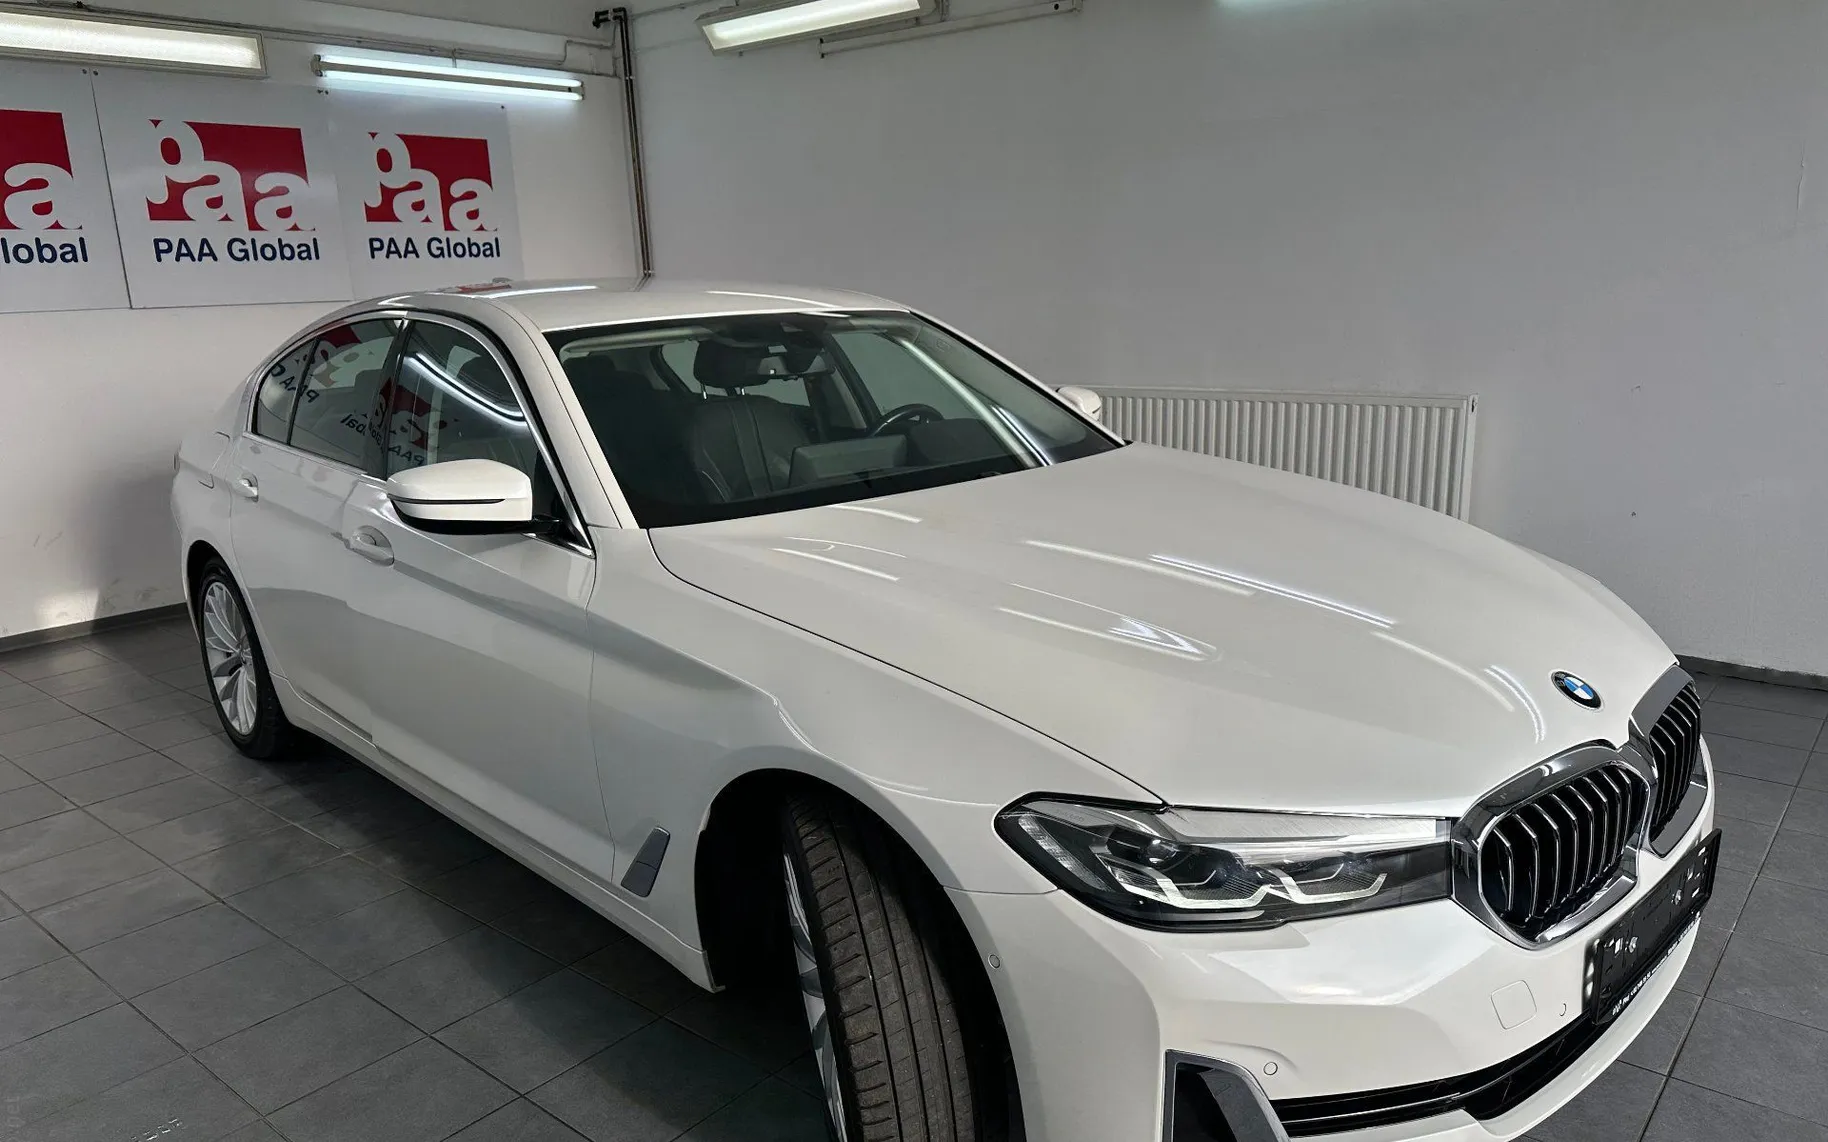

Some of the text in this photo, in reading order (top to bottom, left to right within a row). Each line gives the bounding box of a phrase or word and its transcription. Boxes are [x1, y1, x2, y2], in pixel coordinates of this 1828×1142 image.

[0, 236, 89, 264] lobal
[153, 237, 321, 263] PAA Global
[368, 236, 501, 260] PAA Global
